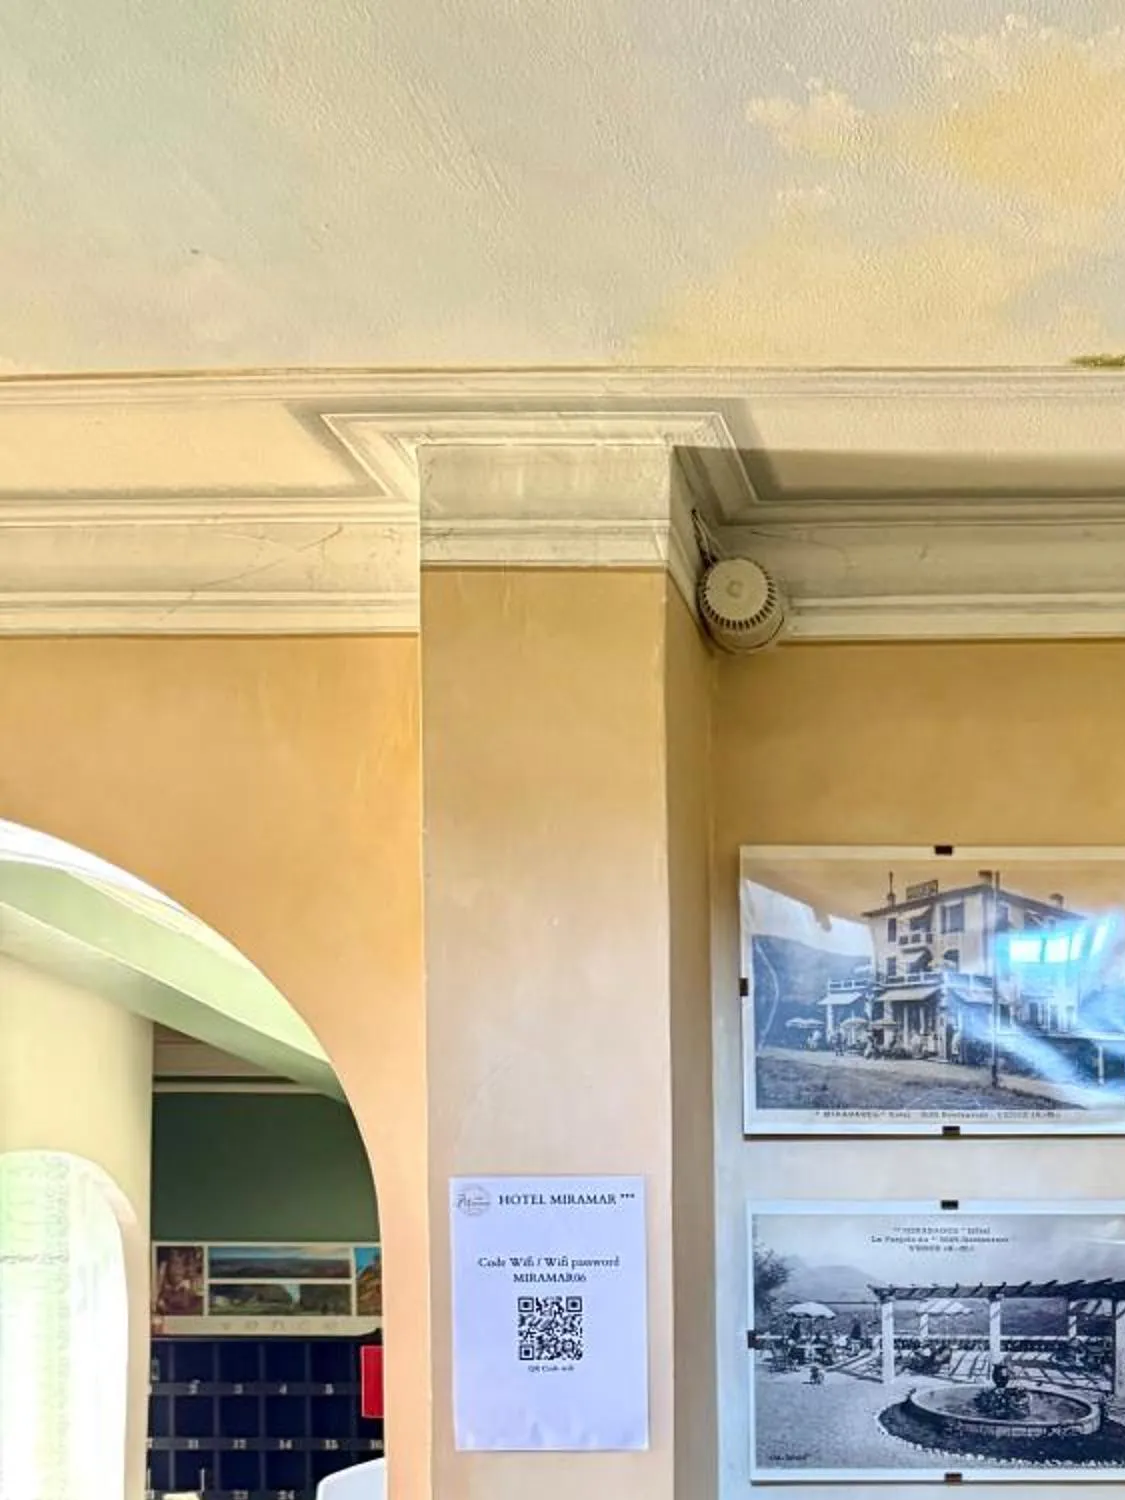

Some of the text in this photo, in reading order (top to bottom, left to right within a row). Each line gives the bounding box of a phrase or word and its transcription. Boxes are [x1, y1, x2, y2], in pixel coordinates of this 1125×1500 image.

[498, 1193, 618, 1206] HOTEL MIRAMAR
[477, 1256, 507, 1268] Code
[509, 1255, 535, 1268] Wifi
[544, 1255, 569, 1268] Wifi
[571, 1255, 621, 1271] password
[512, 1271, 588, 1284] MIRAMAR06
